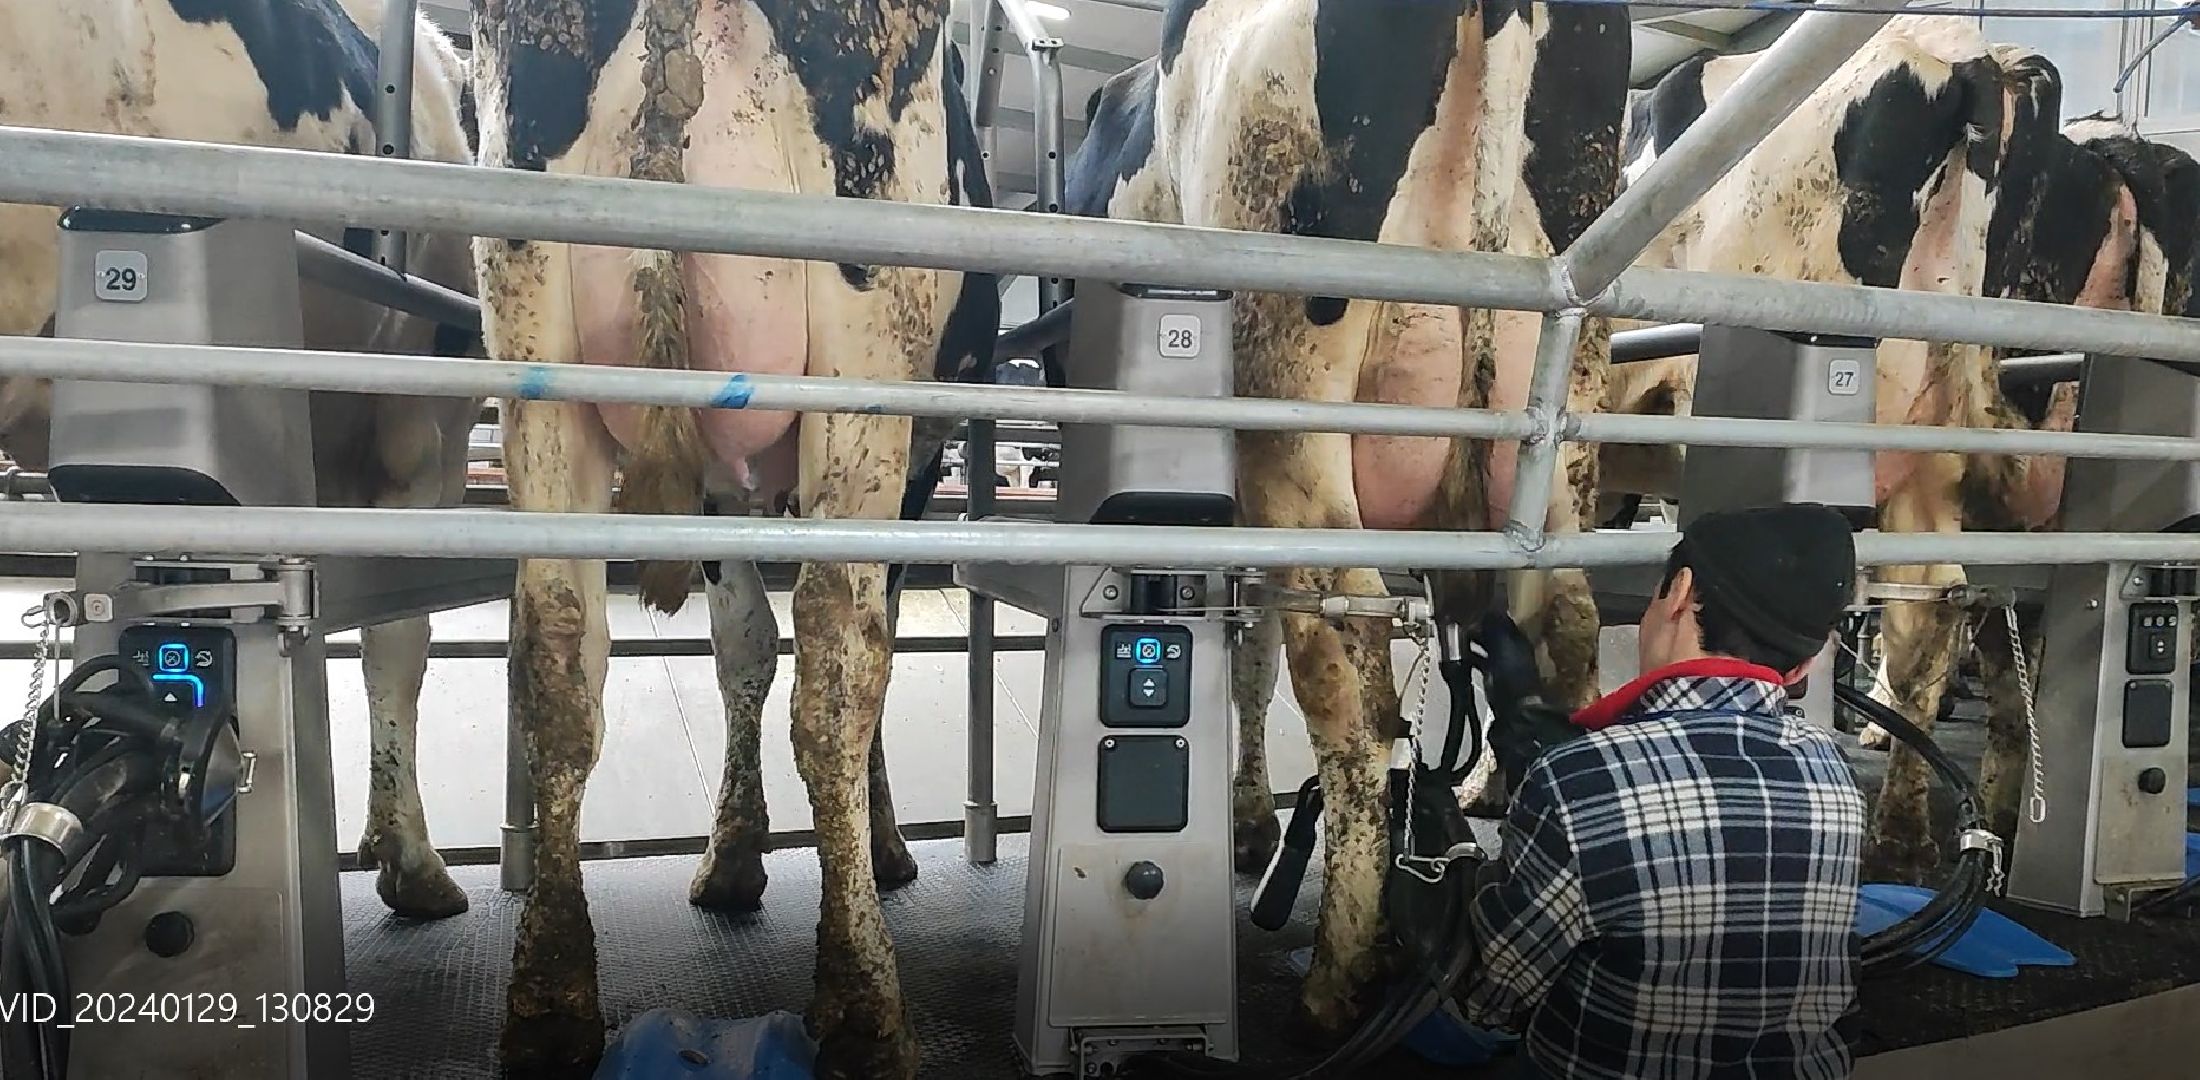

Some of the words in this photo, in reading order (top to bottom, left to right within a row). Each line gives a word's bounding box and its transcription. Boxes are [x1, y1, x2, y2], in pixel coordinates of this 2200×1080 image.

[106, 267, 137, 291] 29
[1168, 330, 1193, 349] 28
[1835, 371, 1855, 388] 27
